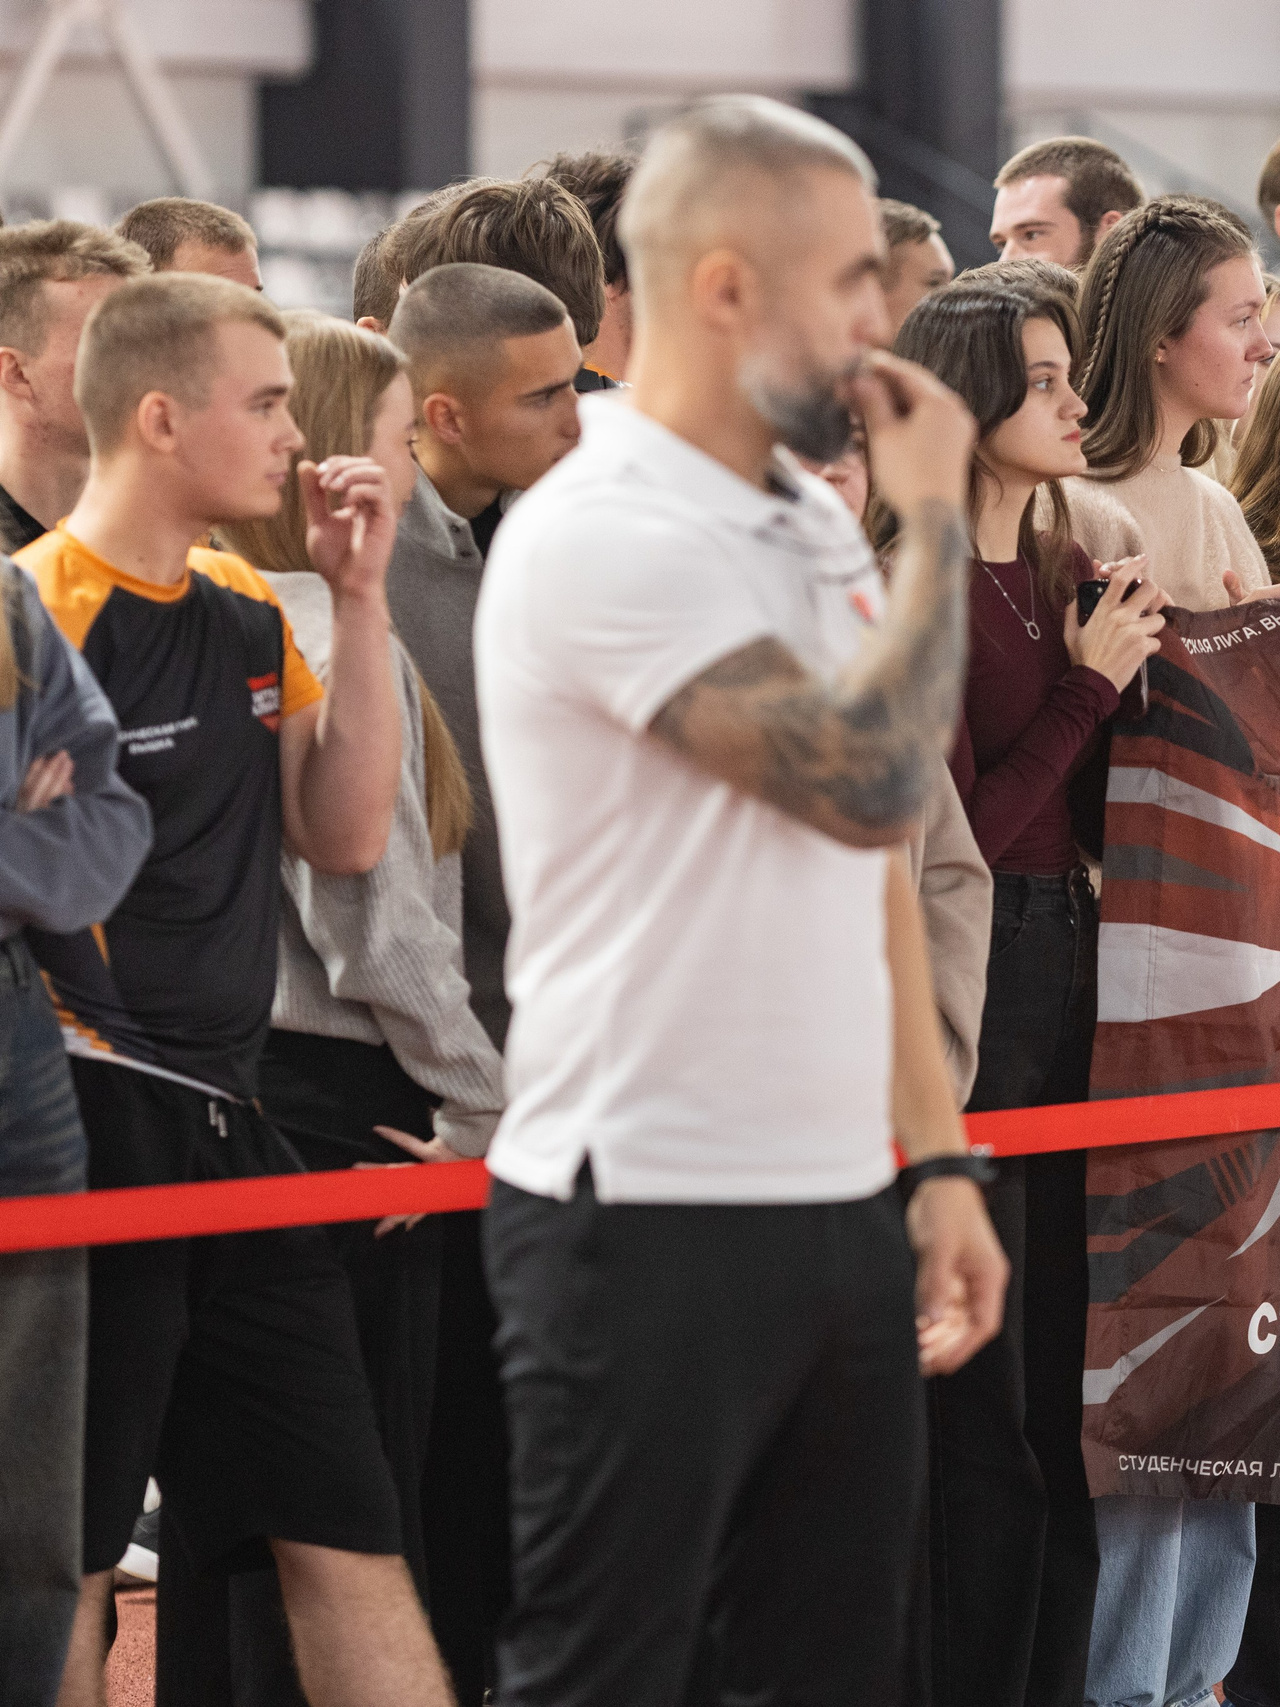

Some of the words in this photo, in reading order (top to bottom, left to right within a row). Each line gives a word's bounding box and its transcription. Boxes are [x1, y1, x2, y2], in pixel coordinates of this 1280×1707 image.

[1181, 637, 1213, 655] СКАЯ
[1213, 626, 1262, 650] ЛИГА.
[1118, 1455, 1263, 1477] СТУДЕНЧЕСКАЯ
